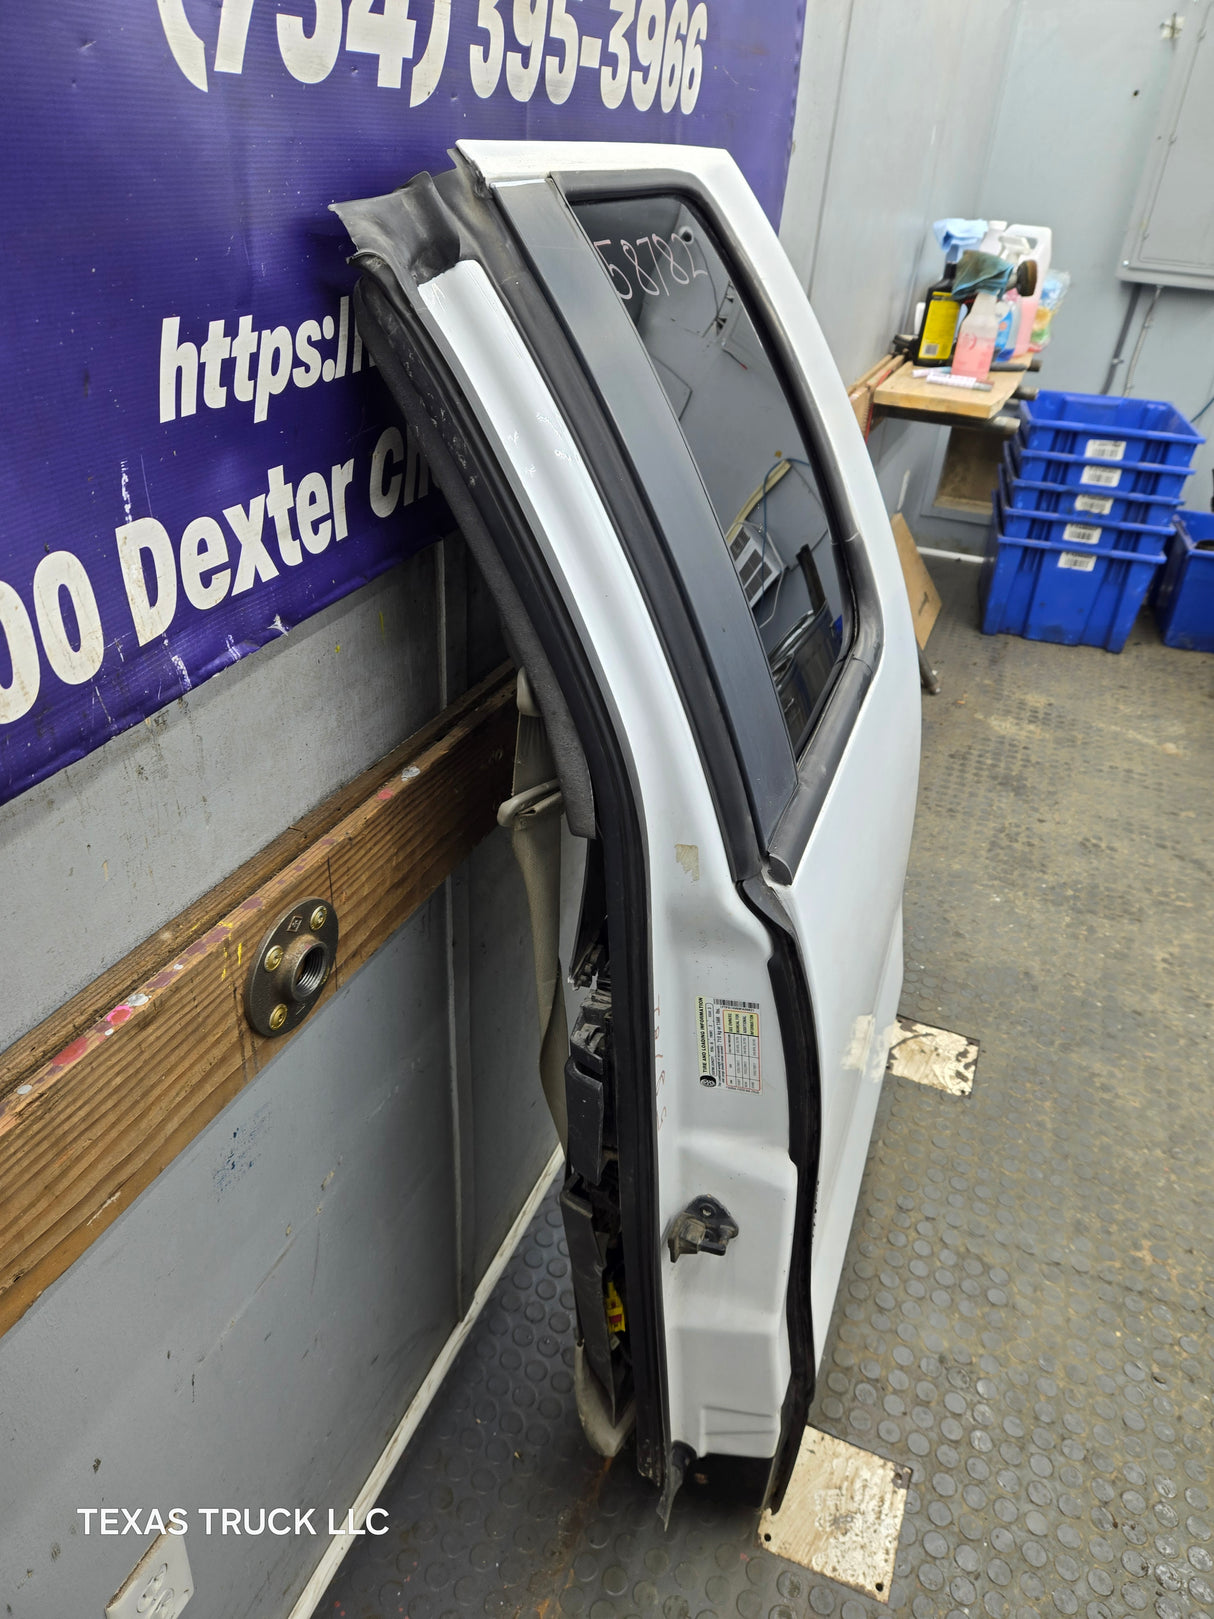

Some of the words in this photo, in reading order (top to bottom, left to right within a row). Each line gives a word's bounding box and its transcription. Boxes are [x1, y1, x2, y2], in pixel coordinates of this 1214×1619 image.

[470, 0, 708, 115] 395-3966
[593, 232, 708, 300] 58782
[160, 296, 376, 424] https://
[115, 458, 354, 648] Dexter
[369, 423, 440, 519] Ch
